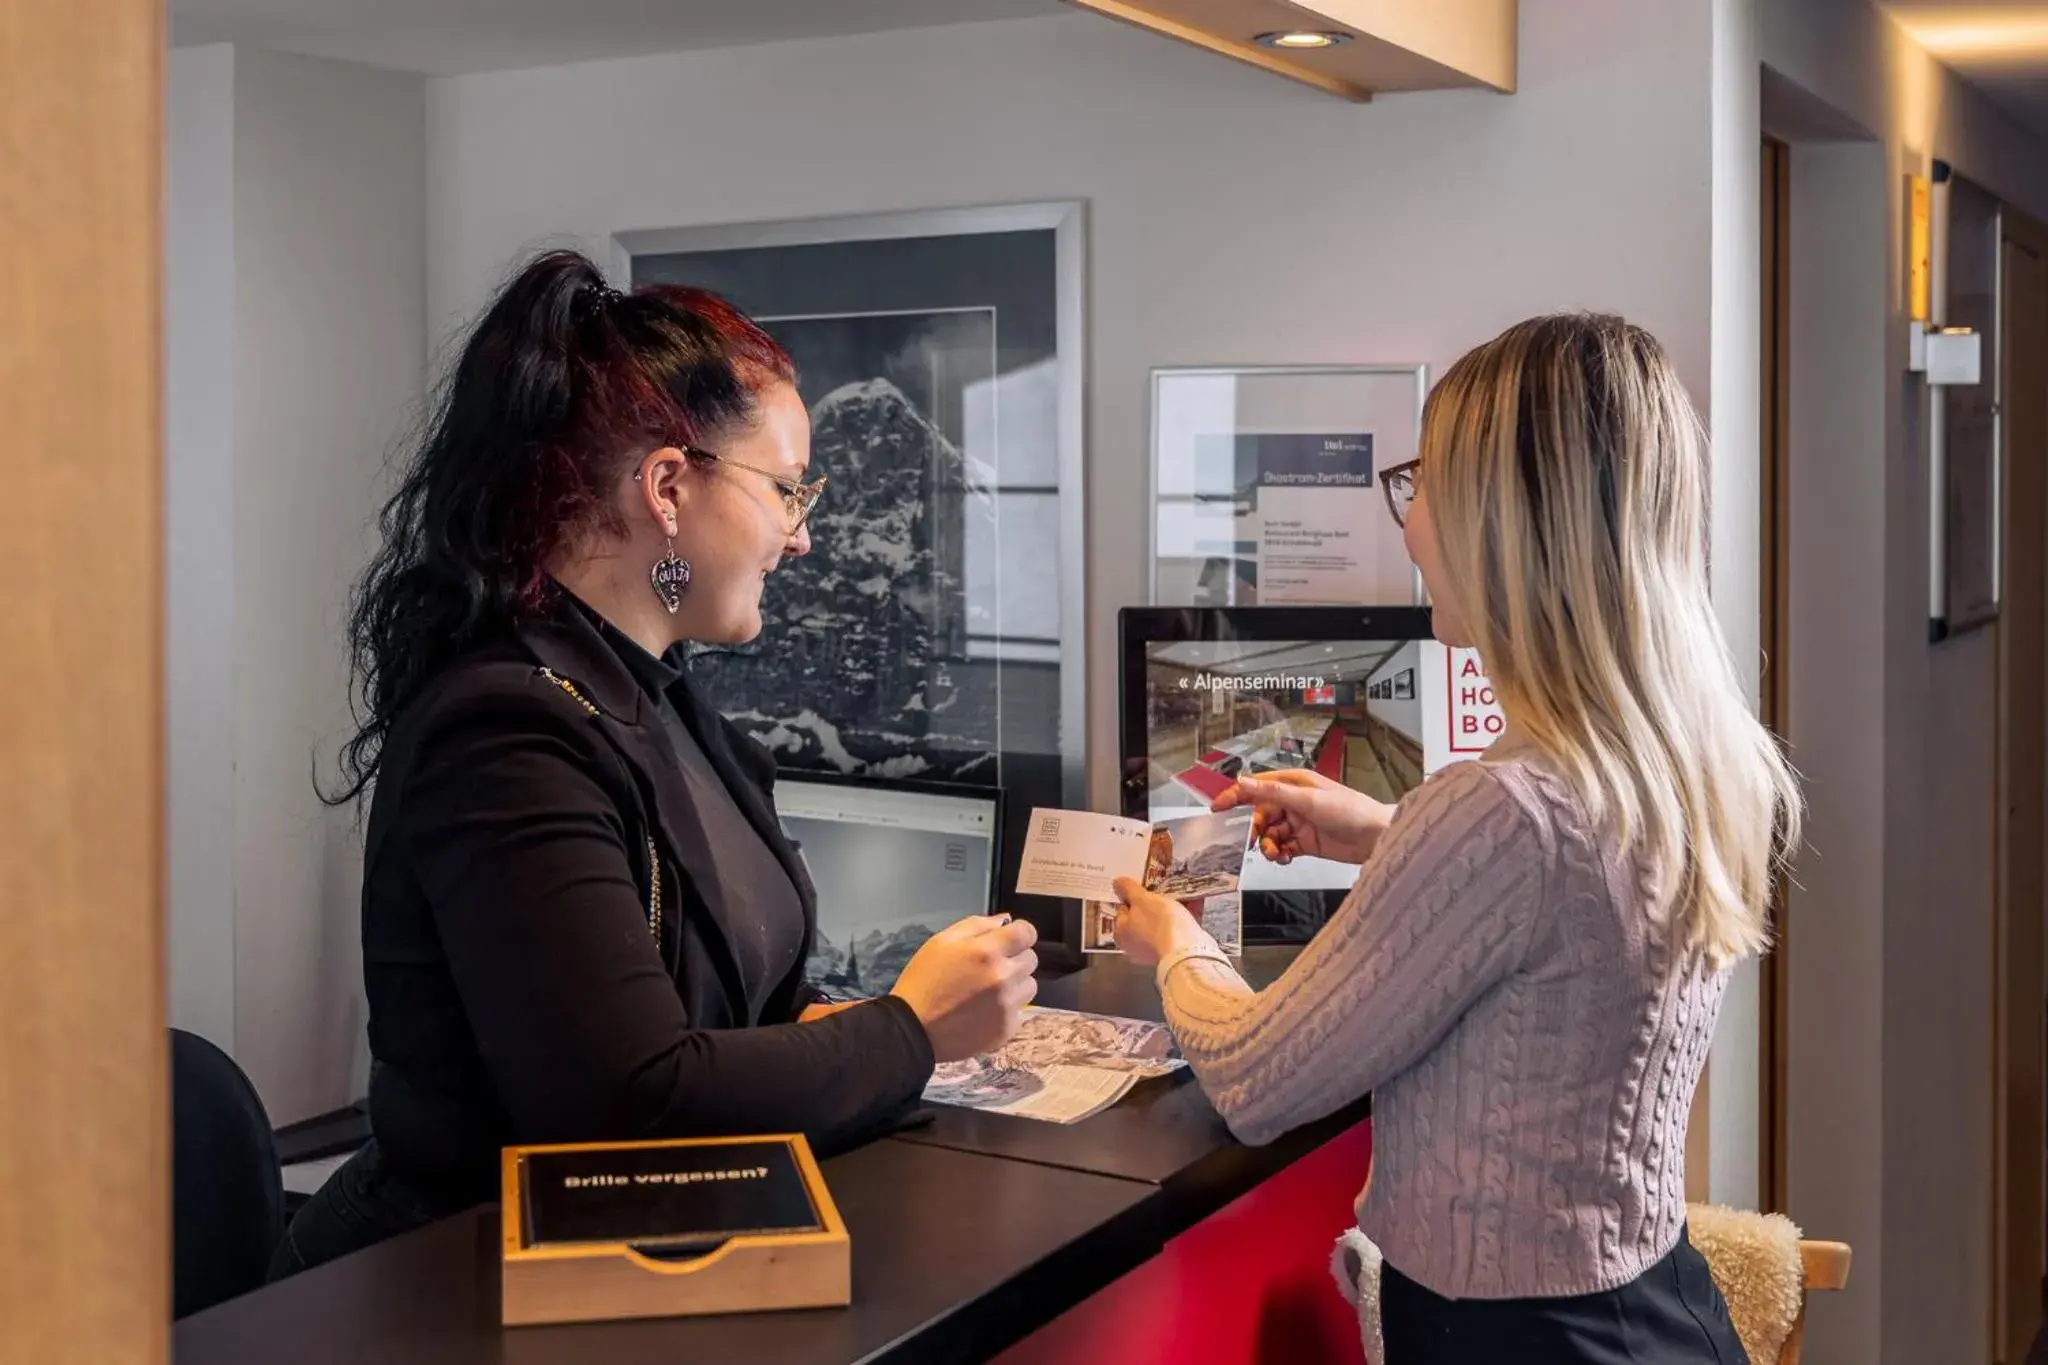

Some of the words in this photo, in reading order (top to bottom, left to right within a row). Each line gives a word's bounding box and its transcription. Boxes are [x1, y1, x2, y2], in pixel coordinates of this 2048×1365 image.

[1462, 687, 1495, 705] HO
[1462, 714, 1503, 733] BO
[565, 1175, 629, 1188] Brille
[634, 1166, 769, 1185] vergessen?
